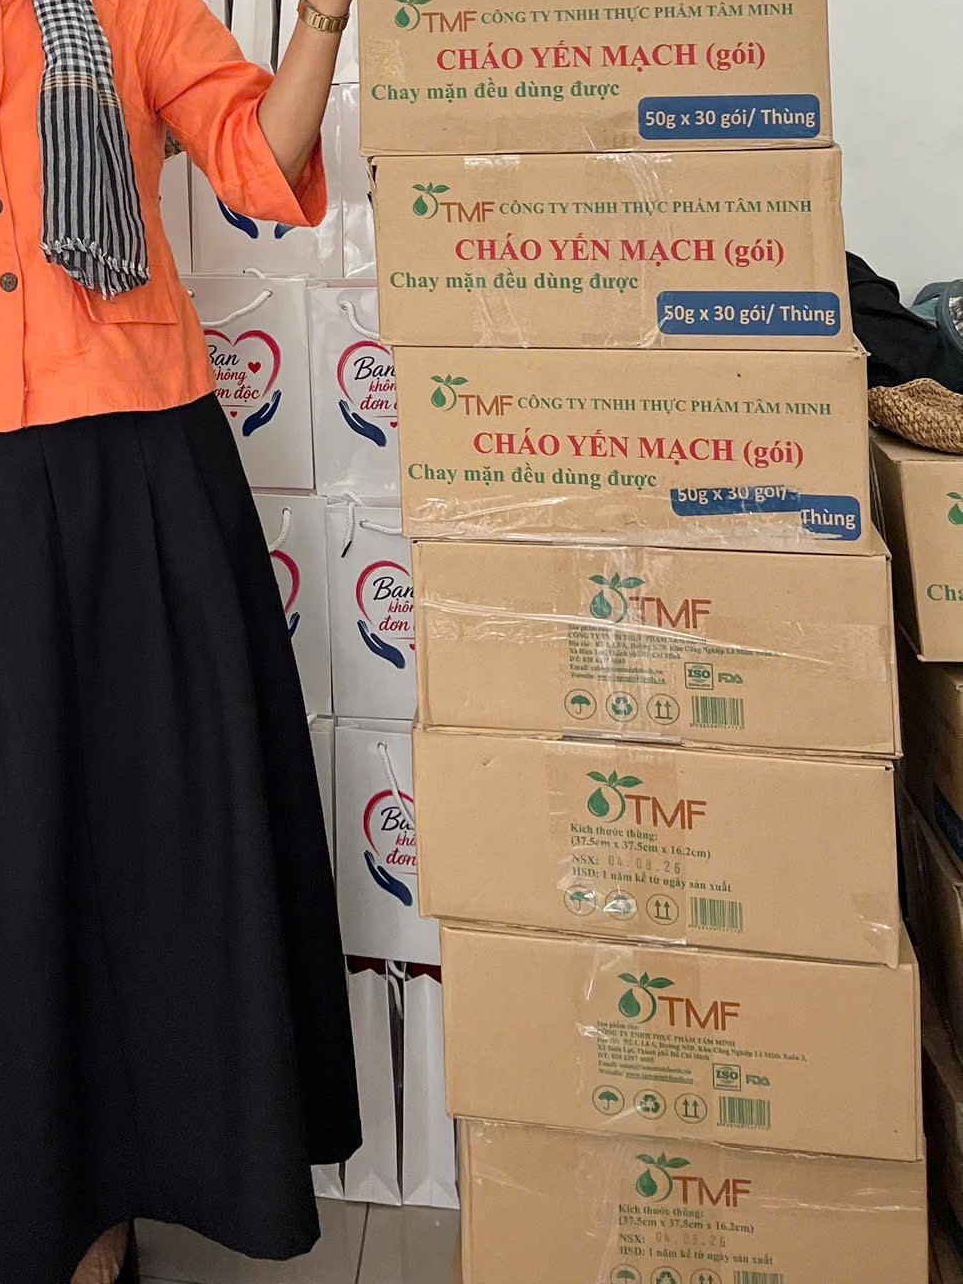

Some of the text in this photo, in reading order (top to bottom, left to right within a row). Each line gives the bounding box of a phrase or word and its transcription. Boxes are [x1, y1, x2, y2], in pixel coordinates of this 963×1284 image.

[421, 10, 477, 33] TMF
[481, 10, 526, 24] CÔNG
[530, 10, 551, 22] TY
[551, 9, 599, 22] TNHH
[604, 6, 650, 22] THỰC
[706, 2, 743, 16] TÂM
[748, 3, 793, 16] MINH
[437, 40, 765, 72] CHÁO YẾN MẠCH (gói)
[371, 78, 619, 104] Chay mặn đều dùng được
[645, 108, 815, 129] 50g x 30 gói/ Thùng
[440, 202, 495, 223] TMF
[499, 200, 544, 214] CÔNG
[549, 202, 571, 214] TY
[572, 202, 617, 214] TNHH
[621, 200, 667, 216] THỰC
[725, 198, 761, 212] TÂM
[766, 200, 812, 212] MINH
[455, 233, 785, 267] CHÁO YẾN MẠCH (gói)
[390, 268, 638, 293] Chay mặn đều dùng được
[664, 303, 835, 325] 50g x 30 gói/ Thùng
[458, 394, 513, 416] TMF
[517, 394, 562, 410] CÔNG
[566, 398, 587, 409] TY
[591, 398, 635, 410] TNHH
[640, 398, 686, 414] THỰC
[744, 398, 780, 414] TÂM
[786, 402, 831, 415] MINH
[473, 428, 804, 468] CHÁO YẾN MẠCH (gói)
[408, 462, 657, 490] Chay mặn đều dùng được
[624, 794, 707, 830] TMF
[571, 823, 593, 834] Kích
[627, 829, 658, 842] thùng:
[571, 836, 610, 848] (37.5cm
[622, 840, 658, 853] 37.5cm
[670, 846, 711, 859] 16.2cm)
[572, 854, 598, 865] NSX:
[573, 867, 599, 878] HSD:
[611, 871, 632, 881] năm
[663, 876, 686, 889] ngày
[709, 880, 732, 892] xuất
[658, 996, 741, 1031] TMF
[672, 1176, 752, 1207] TMF
